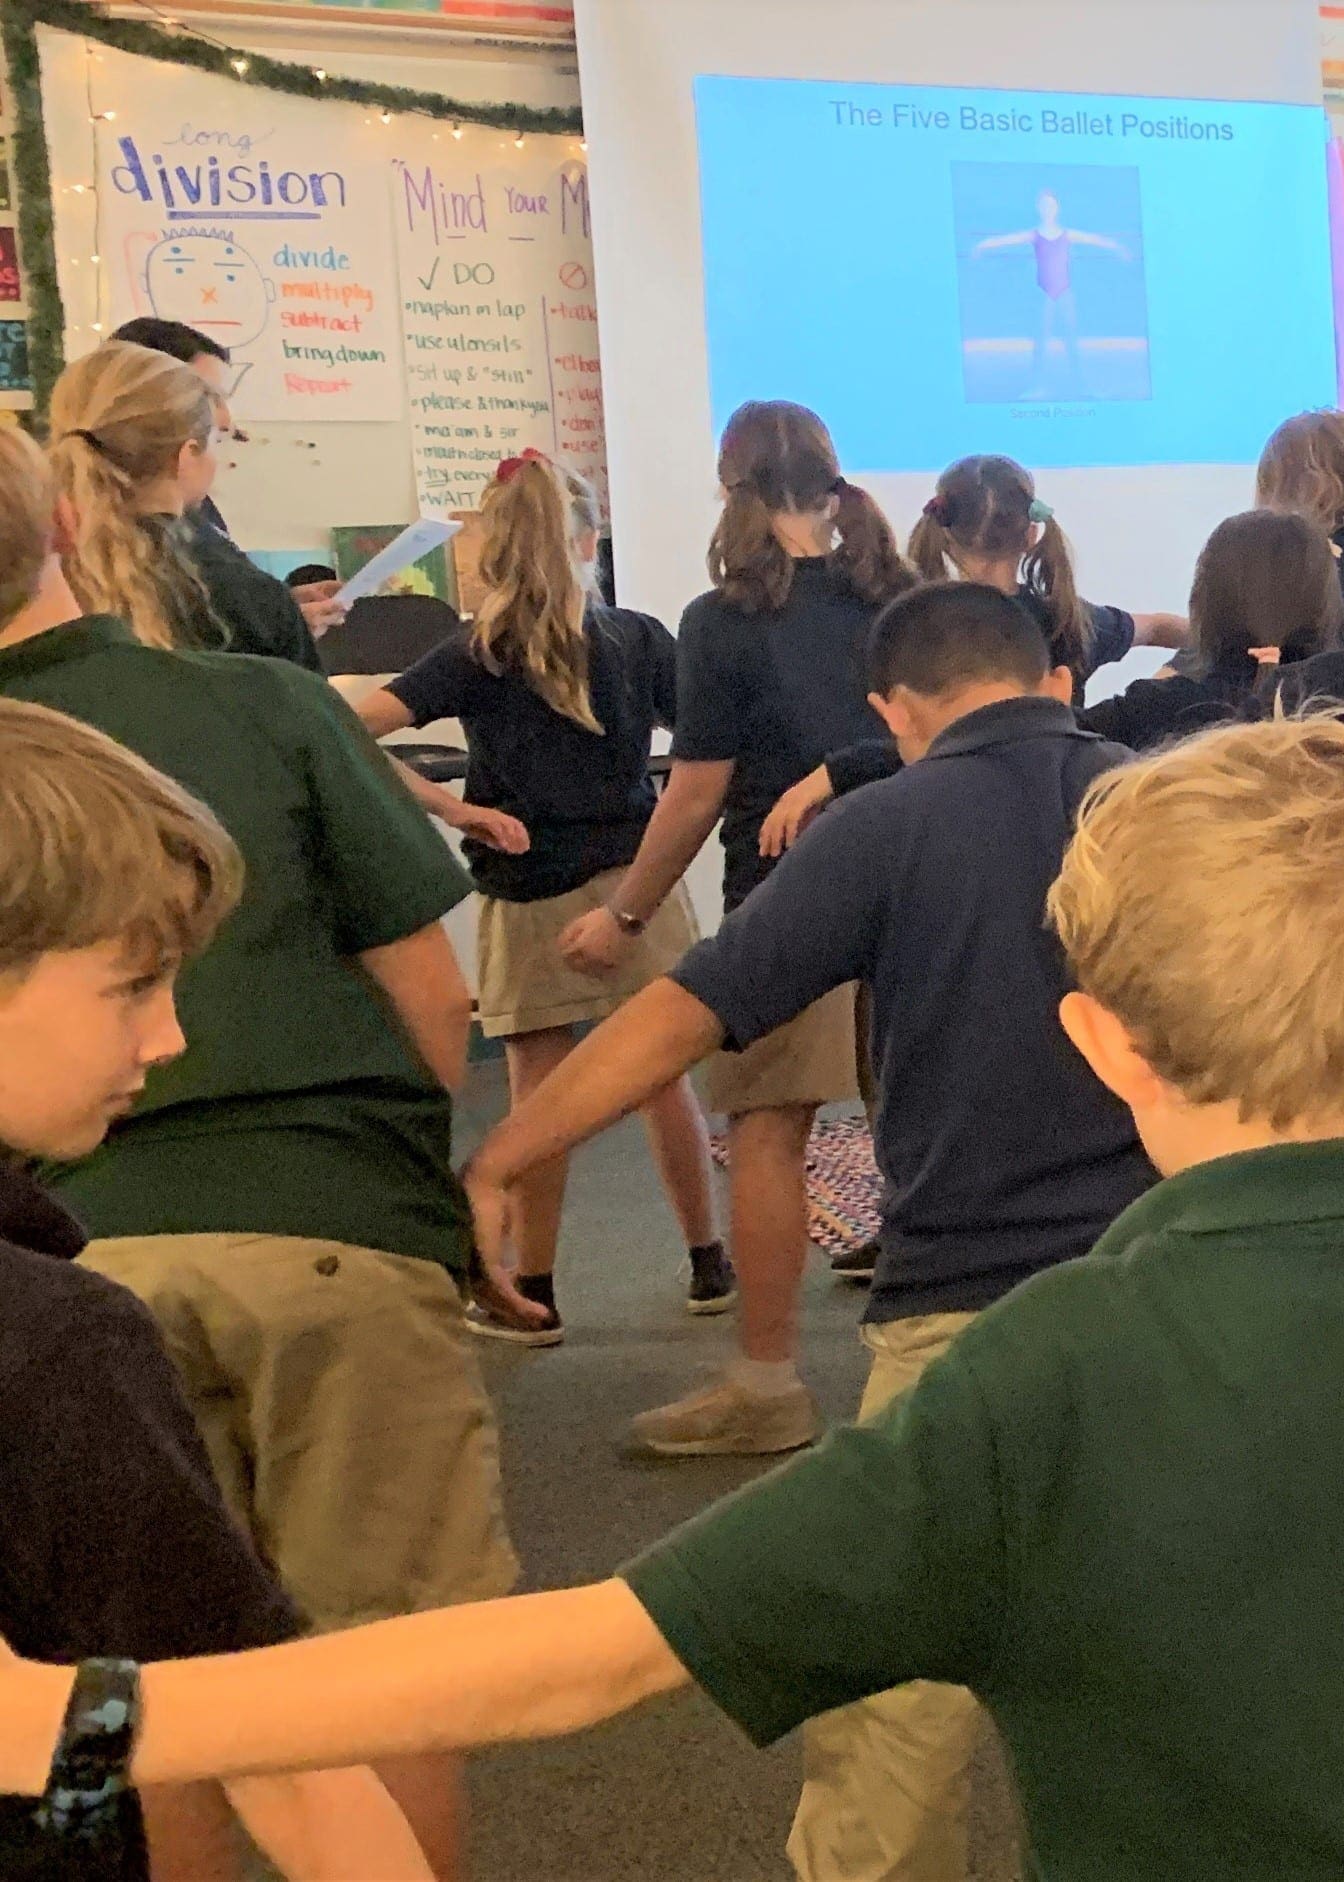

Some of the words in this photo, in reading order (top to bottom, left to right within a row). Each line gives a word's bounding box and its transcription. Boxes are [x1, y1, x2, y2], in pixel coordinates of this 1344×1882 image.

[829, 100, 882, 127] The
[893, 103, 950, 129] Five
[960, 106, 1033, 133] Basic
[1041, 110, 1113, 137] Ballet
[1122, 113, 1234, 141] Positions
[163, 123, 276, 158] long
[111, 136, 345, 208] division
[403, 166, 489, 245] Mind
[273, 244, 350, 271] divide
[453, 262, 495, 285] DO
[281, 282, 374, 312] multiply
[497, 299, 525, 320] lap
[281, 311, 362, 332] subtract
[443, 368, 462, 386] up
[427, 490, 476, 507] WAIT
